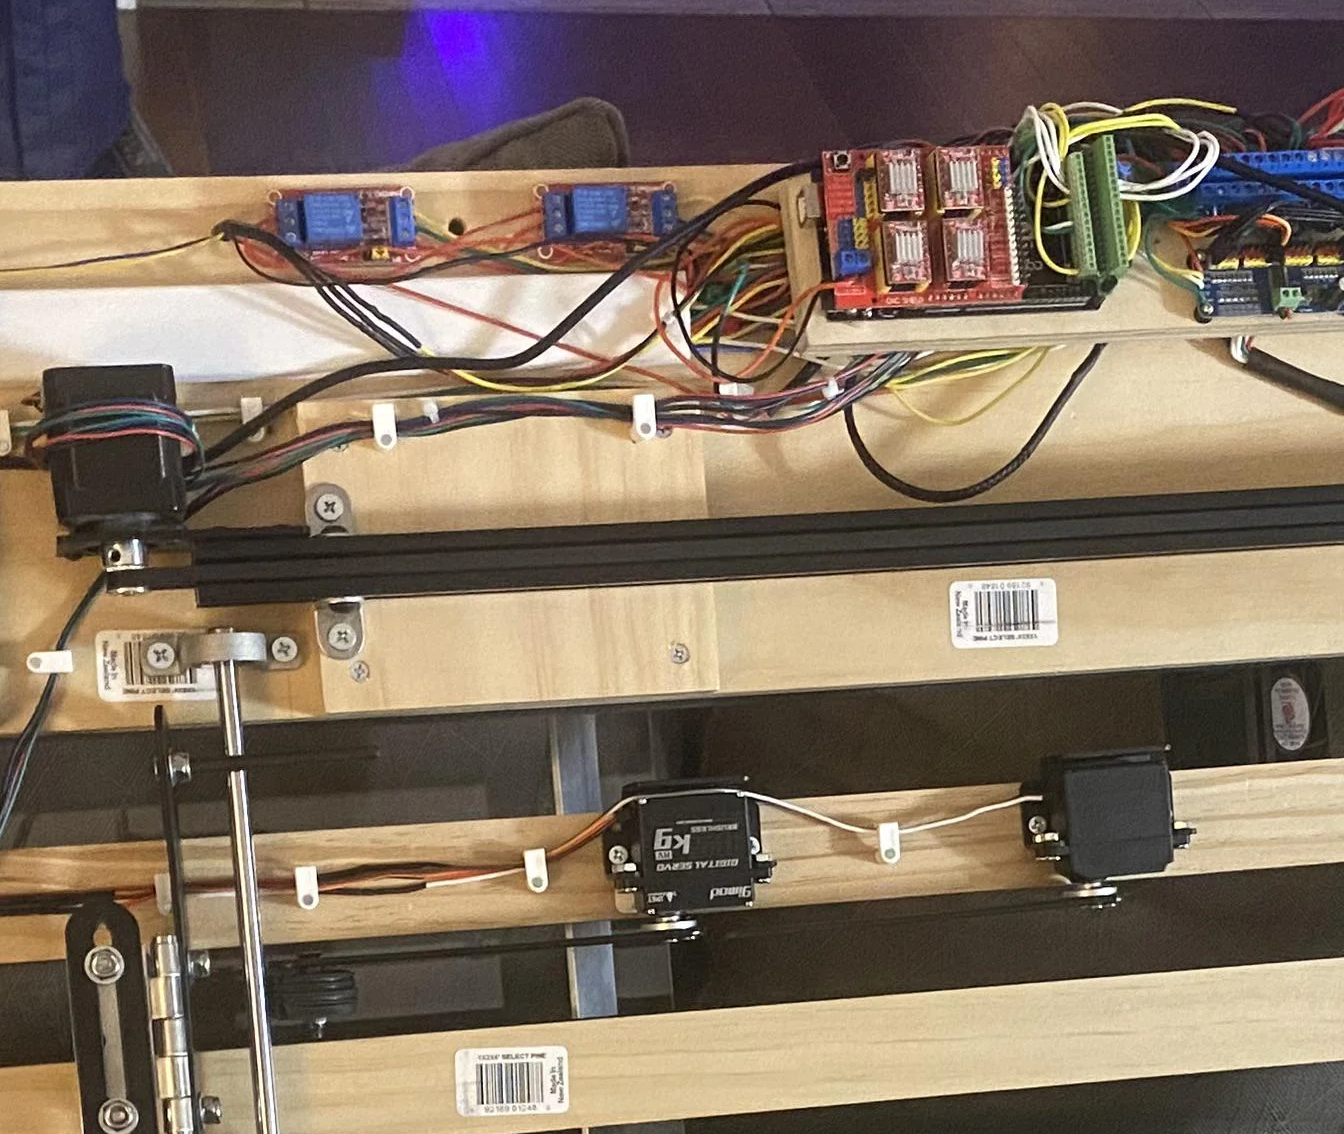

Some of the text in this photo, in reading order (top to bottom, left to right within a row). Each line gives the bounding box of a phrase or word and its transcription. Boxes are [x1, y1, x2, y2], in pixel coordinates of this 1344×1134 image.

[653, 828, 691, 855] kg
[656, 858, 739, 872] DIGITAL SERVO
